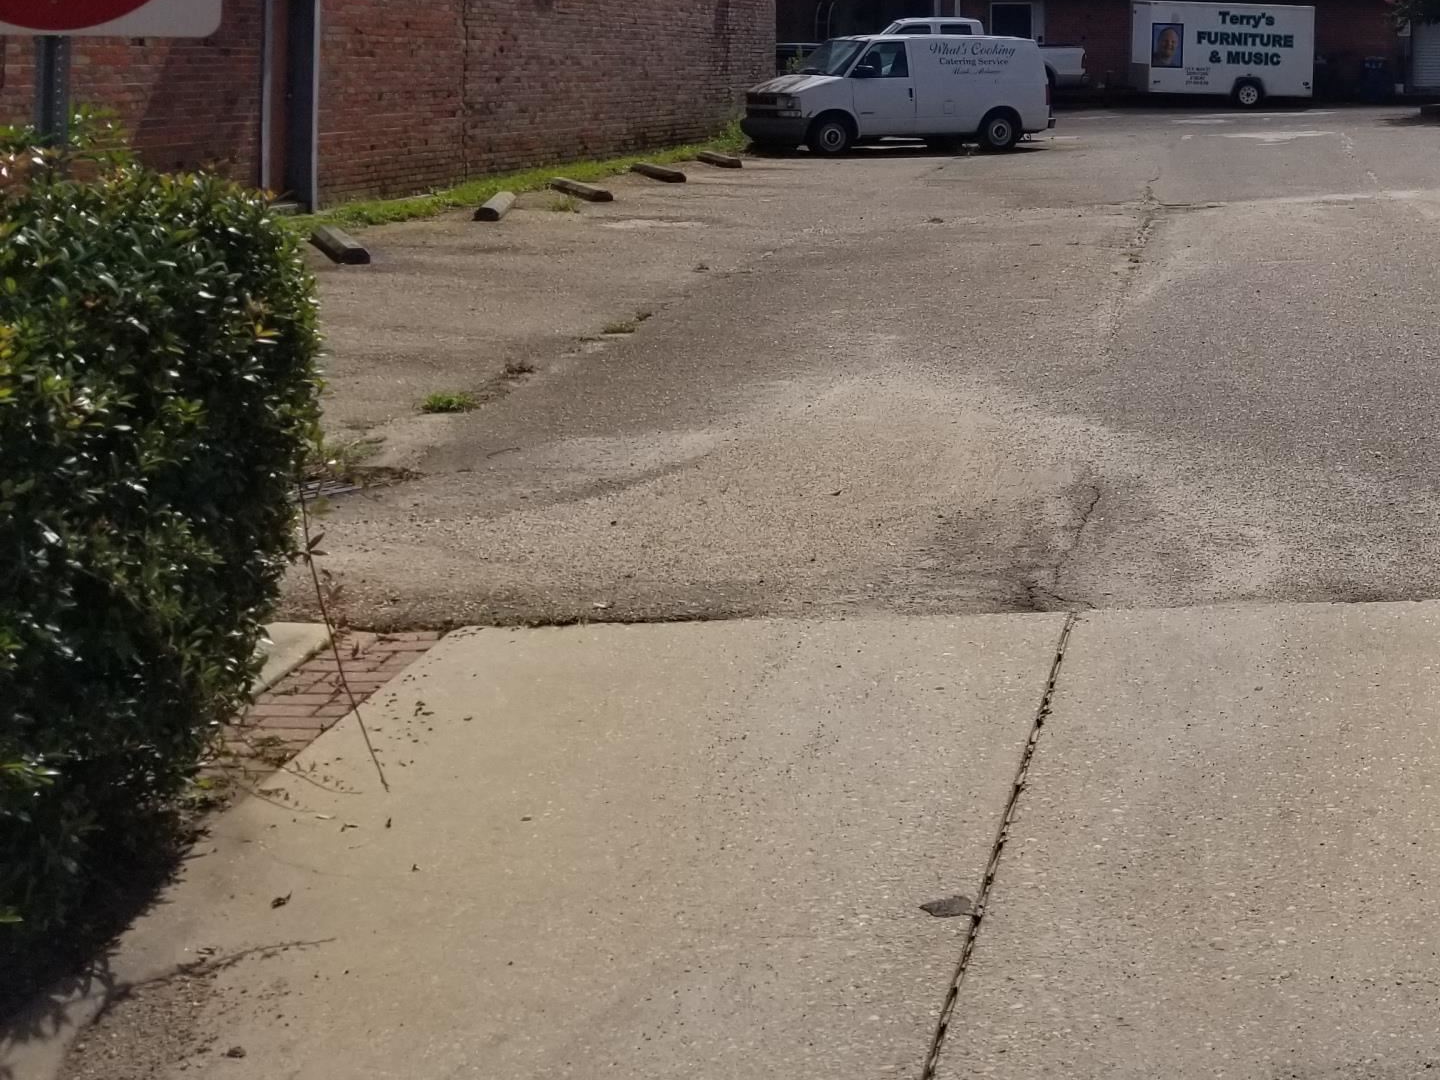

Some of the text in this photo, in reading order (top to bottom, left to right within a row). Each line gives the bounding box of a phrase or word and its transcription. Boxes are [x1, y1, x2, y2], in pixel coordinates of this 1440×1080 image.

[1218, 11, 1275, 29] Terry's
[1196, 31, 1294, 48] FURNITURE
[929, 41, 1016, 57] What's Cooking
[939, 57, 977, 66] Catering
[1208, 50, 1281, 66] & MUSIC
